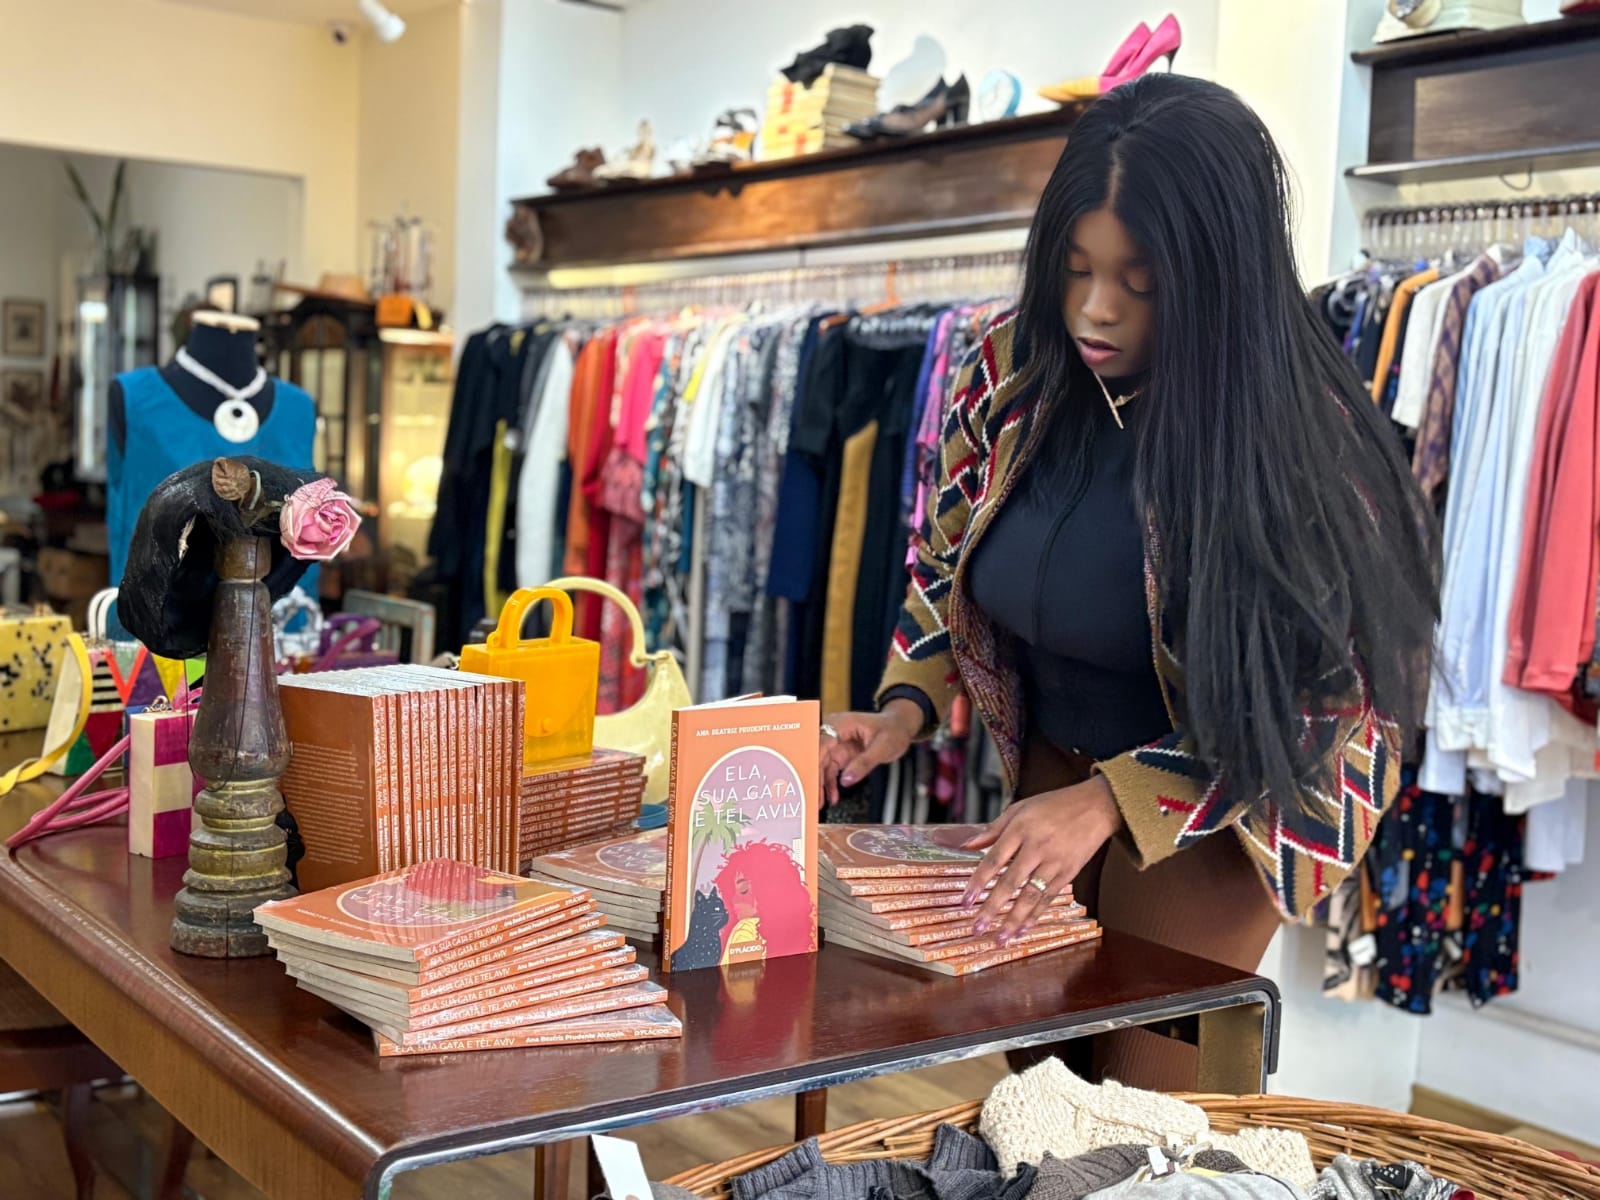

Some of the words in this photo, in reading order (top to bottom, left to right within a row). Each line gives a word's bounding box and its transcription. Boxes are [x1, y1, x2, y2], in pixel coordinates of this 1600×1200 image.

[739, 724, 771, 733] PRUDENTE
[726, 764, 767, 782] ELA,
[700, 787, 738, 805] SUA
[746, 782, 796, 800] GATA
[696, 812, 705, 827] E
[714, 808, 748, 825] TEL
[756, 802, 800, 820] AVIV
[482, 971, 494, 982] TEL
[496, 967, 510, 978] AVIV
[486, 987, 499, 998] TEL
[500, 983, 514, 994] AVIV
[488, 1003, 500, 1013] TEL
[503, 999, 520, 1010] AVIV
[418, 1043, 438, 1052] SUA
[439, 1042, 465, 1050] GATA
[475, 1040, 491, 1048] TEL
[494, 1039, 515, 1047] AVIV
